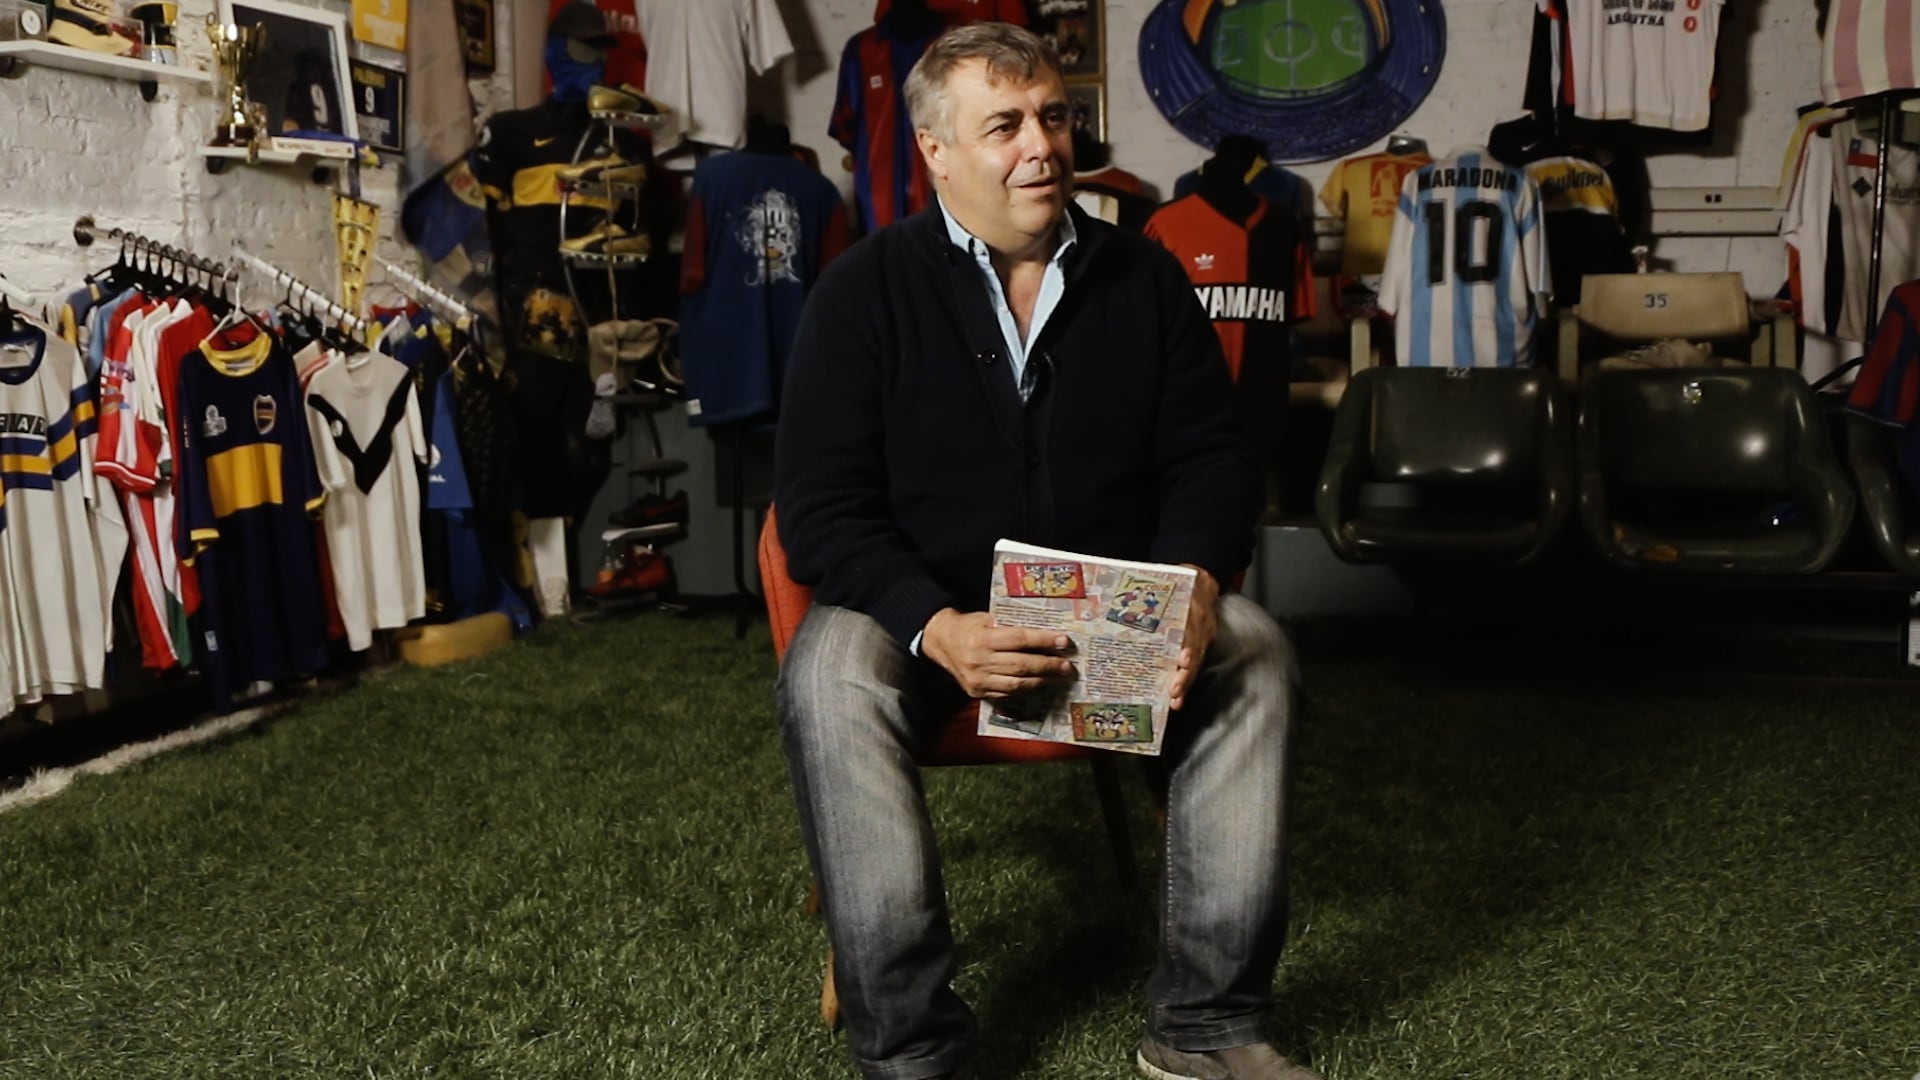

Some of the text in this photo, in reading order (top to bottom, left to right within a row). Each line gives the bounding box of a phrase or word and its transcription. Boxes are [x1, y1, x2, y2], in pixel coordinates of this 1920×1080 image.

[310, 83, 328, 125] 9
[365, 86, 375, 113] 9
[1418, 167, 1516, 192] MARADONA
[1426, 199, 1503, 284] 10
[1193, 285, 1285, 322] YAMAHA
[1645, 293, 1668, 308] 35
